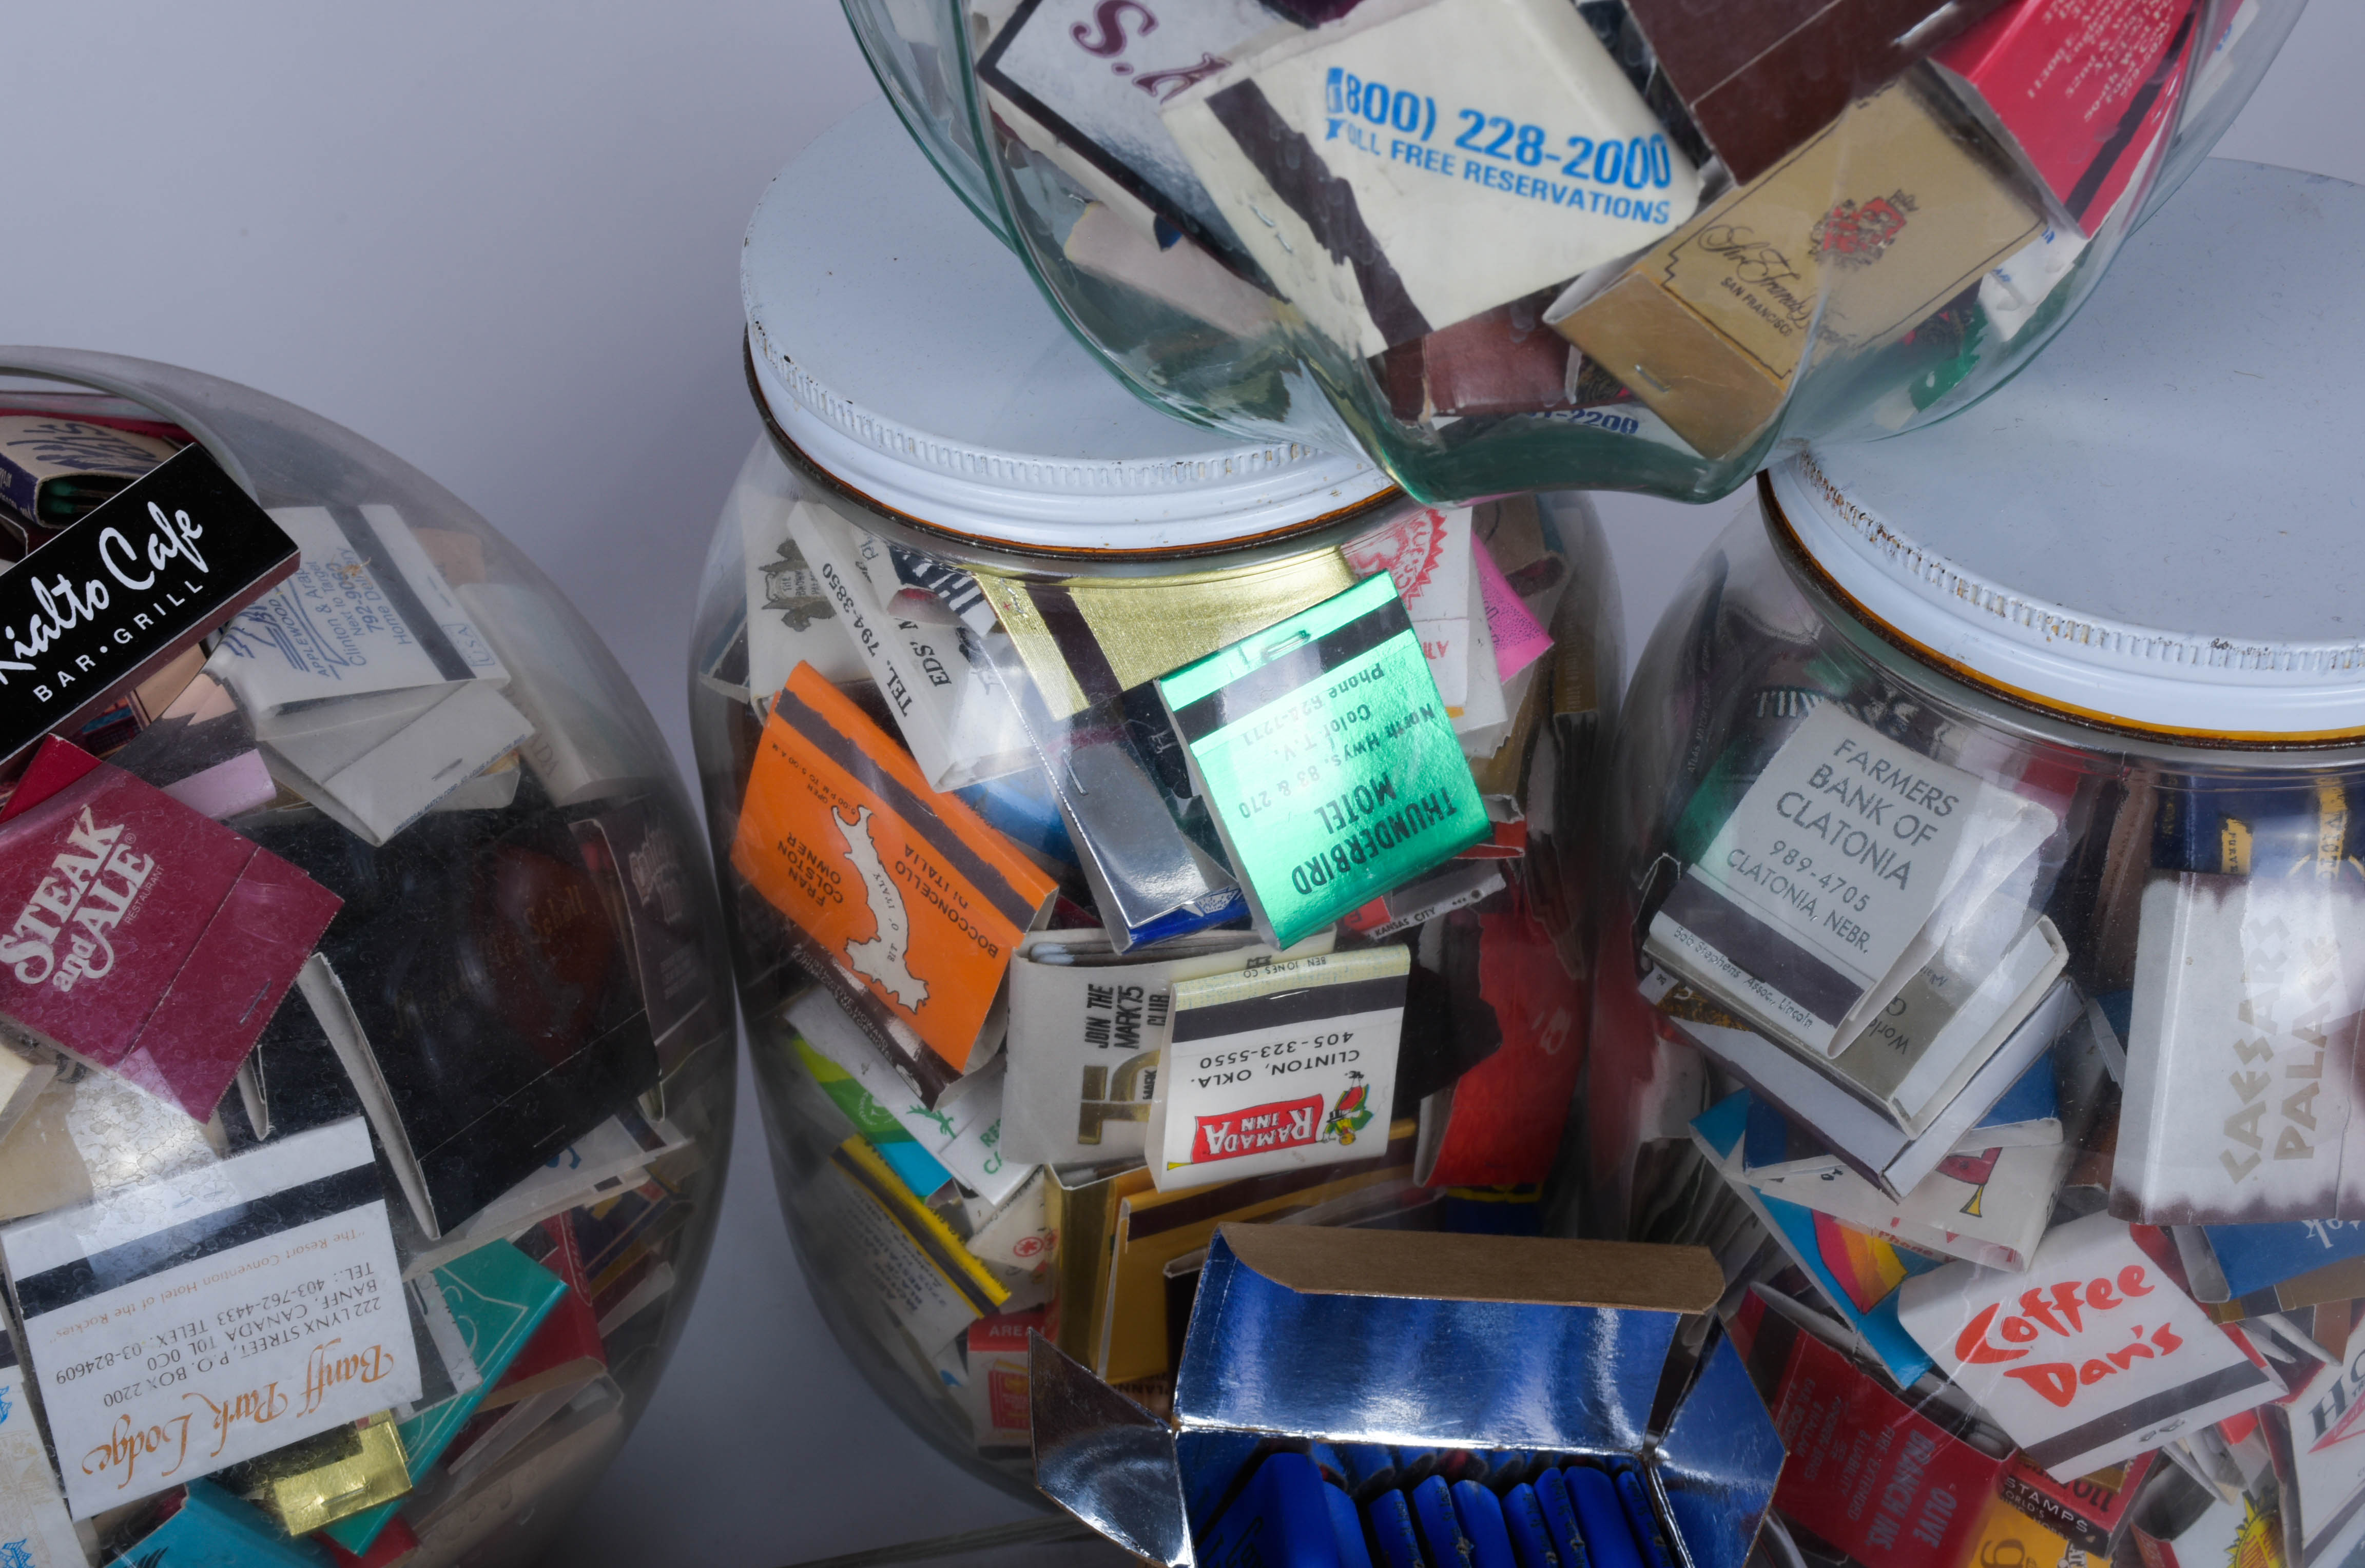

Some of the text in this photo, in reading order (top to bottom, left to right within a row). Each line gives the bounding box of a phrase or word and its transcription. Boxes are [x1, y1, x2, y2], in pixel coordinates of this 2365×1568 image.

[1455, 108, 1671, 190] 228-2000
[1390, 139, 1456, 177] FREE
[1464, 160, 1670, 225] RESERVATIONS
[1721, 275, 1794, 338] SAN FRANCISCO
[100, 502, 209, 590] Cafe
[377, 601, 412, 645] Home
[822, 562, 879, 658] 794-3850
[33, 581, 203, 702] BAR GRILL
[268, 597, 330, 678] APPLEWOOD
[328, 611, 367, 667] Clinton
[885, 660, 913, 717] TEL.
[1325, 662, 1386, 703] Phone
[1319, 701, 1373, 740] Color
[1382, 701, 1438, 741] North
[1320, 730, 1383, 774] Hwys.
[804, 783, 830, 804] OPEN
[807, 773, 821, 785] TO
[1313, 772, 1397, 835] MOTEL
[1833, 738, 1959, 818] FARMERS
[1235, 789, 1274, 820] 270
[1808, 763, 1938, 847] BANK OF
[786, 831, 842, 885] OWNER
[1291, 786, 1457, 896] THUNDERBIRD
[1776, 790, 1913, 890] CLATONIA
[0, 803, 125, 984] STEAK
[778, 839, 844, 904] COLSTON
[788, 866, 826, 908] FRAN
[873, 872, 896, 911] ITALY
[904, 843, 950, 894] ITALIA
[1769, 840, 1871, 913] 989-4705
[52, 843, 155, 992] and ALE
[895, 860, 999, 958] BOCCONCELLO
[1373, 916, 1410, 937] KANSAS
[1412, 906, 1438, 924] CITY
[1726, 849, 1870, 955] CLATONIA, NEBR.
[886, 942, 898, 963] BIT
[1242, 956, 1326, 978] BEN JONES CO
[1672, 925, 1698, 948] Bob
[1693, 939, 1744, 982] Stephens
[1776, 995, 1817, 1031] Lincoln
[1082, 983, 1114, 1049] JOIN THE
[1112, 1004, 1143, 1050] MARK
[1189, 1048, 1361, 1090] CLINTON, OKLA.
[1197, 1030, 1355, 1070] 405-323-5550
[2219, 917, 2291, 1184] CAESARS
[1201, 1105, 1317, 1155] RAMADA
[1238, 1111, 1281, 1132] INN
[283, 1235, 329, 1262] Resort
[1877, 1230, 1936, 1257] Phone
[159, 1280, 199, 1304] Hotel
[201, 1251, 282, 1289] Convention
[112, 1301, 138, 1321] the
[214, 1276, 327, 1326] 403-762-4433
[222, 1301, 309, 1344] CANADA
[302, 1306, 352, 1336] LYNX
[352, 1296, 382, 1318] 222
[1954, 1265, 2155, 1365] Coffee
[52, 1341, 144, 1386] 03-824609
[144, 1365, 188, 1391] BOX
[2003, 1322, 2184, 1407] Dan's
[81, 1337, 394, 1489] Banff Park Lodge
[100, 1381, 145, 1408] 2200
[1877, 1426, 1940, 1520] BRANCH
[1909, 1484, 1960, 1551] OLIVE
[2004, 1474, 2091, 1535] STAMPS
